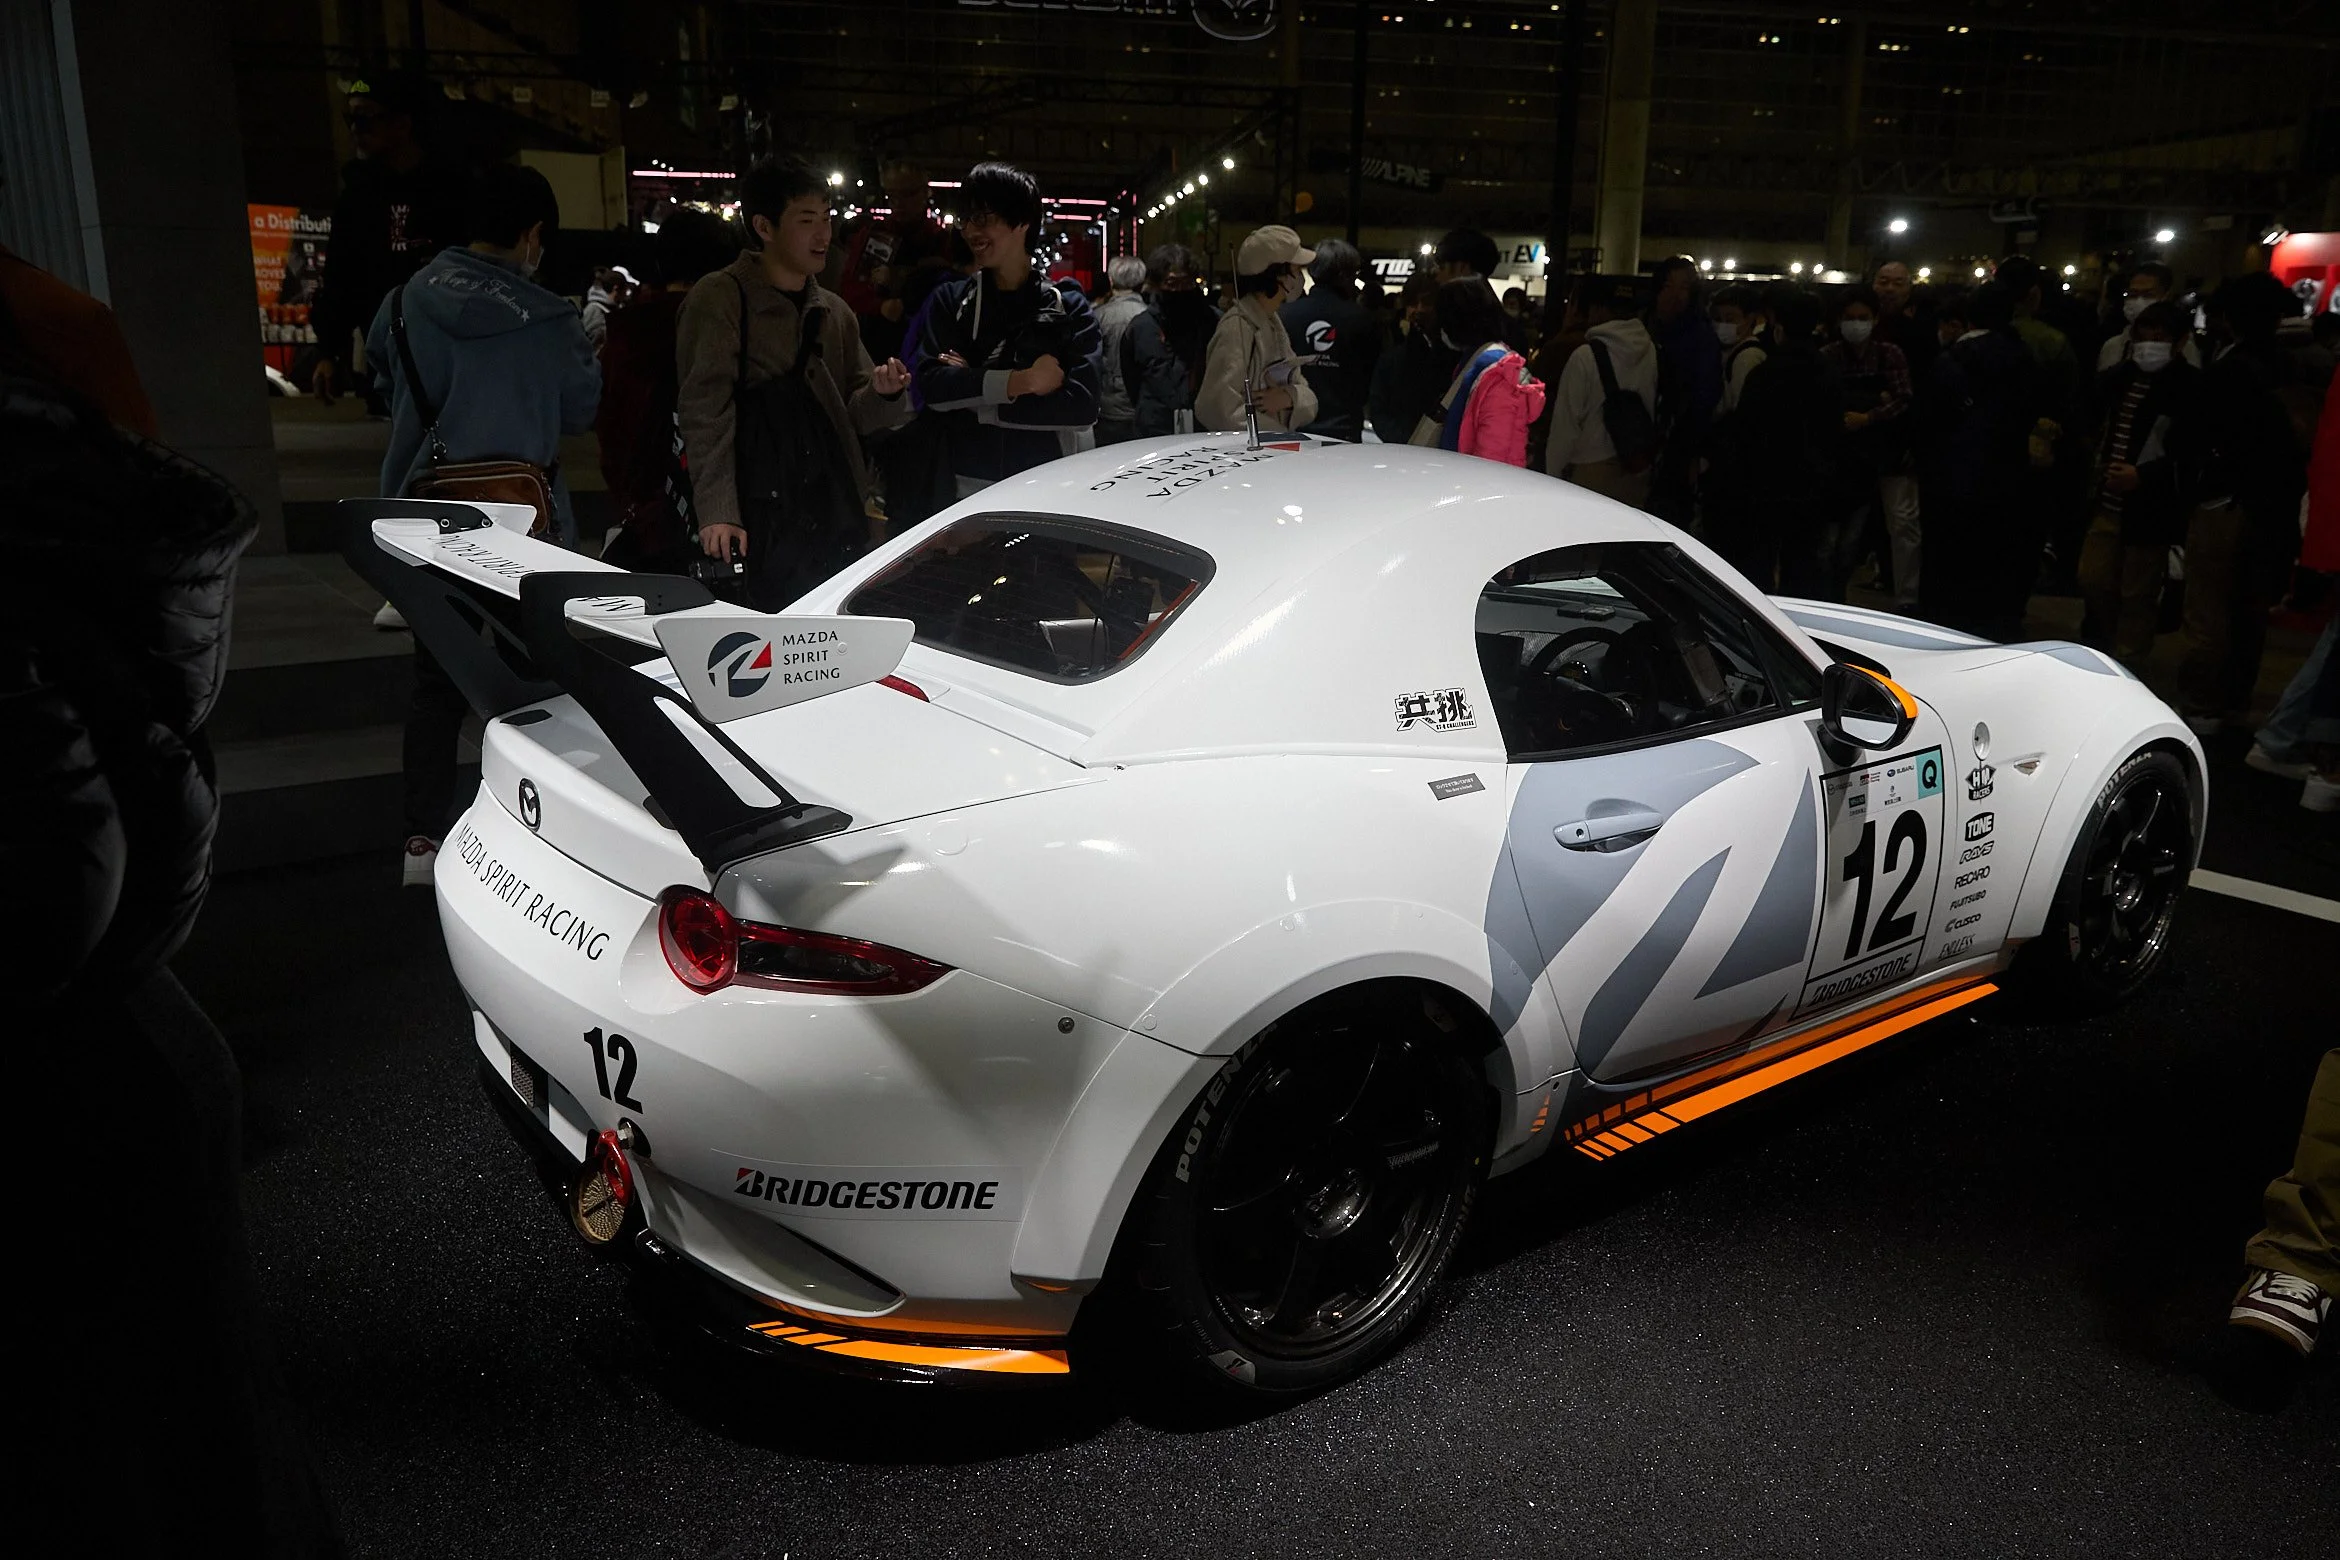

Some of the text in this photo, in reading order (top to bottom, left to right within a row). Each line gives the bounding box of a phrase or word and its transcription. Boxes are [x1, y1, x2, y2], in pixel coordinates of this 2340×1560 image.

[1513, 244, 1541, 263] EV
[1090, 446, 1218, 492] RACING
[1146, 451, 1246, 484] SPIRIT
[1146, 454, 1274, 498] MAZDA
[782, 630, 839, 647] MAZDA
[783, 650, 828, 666] SPIRIT
[783, 667, 841, 685] RACING
[1922, 759, 1938, 789] Q
[1967, 816, 1993, 839] TONE
[1959, 841, 1994, 864] RAYS
[455, 823, 610, 961] MAZDA SPIRIT RACING
[1843, 809, 1928, 961] 12
[1954, 866, 1991, 889] RECARO
[1950, 890, 1987, 911] FUJITSUBO
[1807, 953, 1913, 1007] BRIDGESTONE
[583, 1026, 644, 1115] 12
[734, 1167, 999, 1210] BRIDGESTONE
